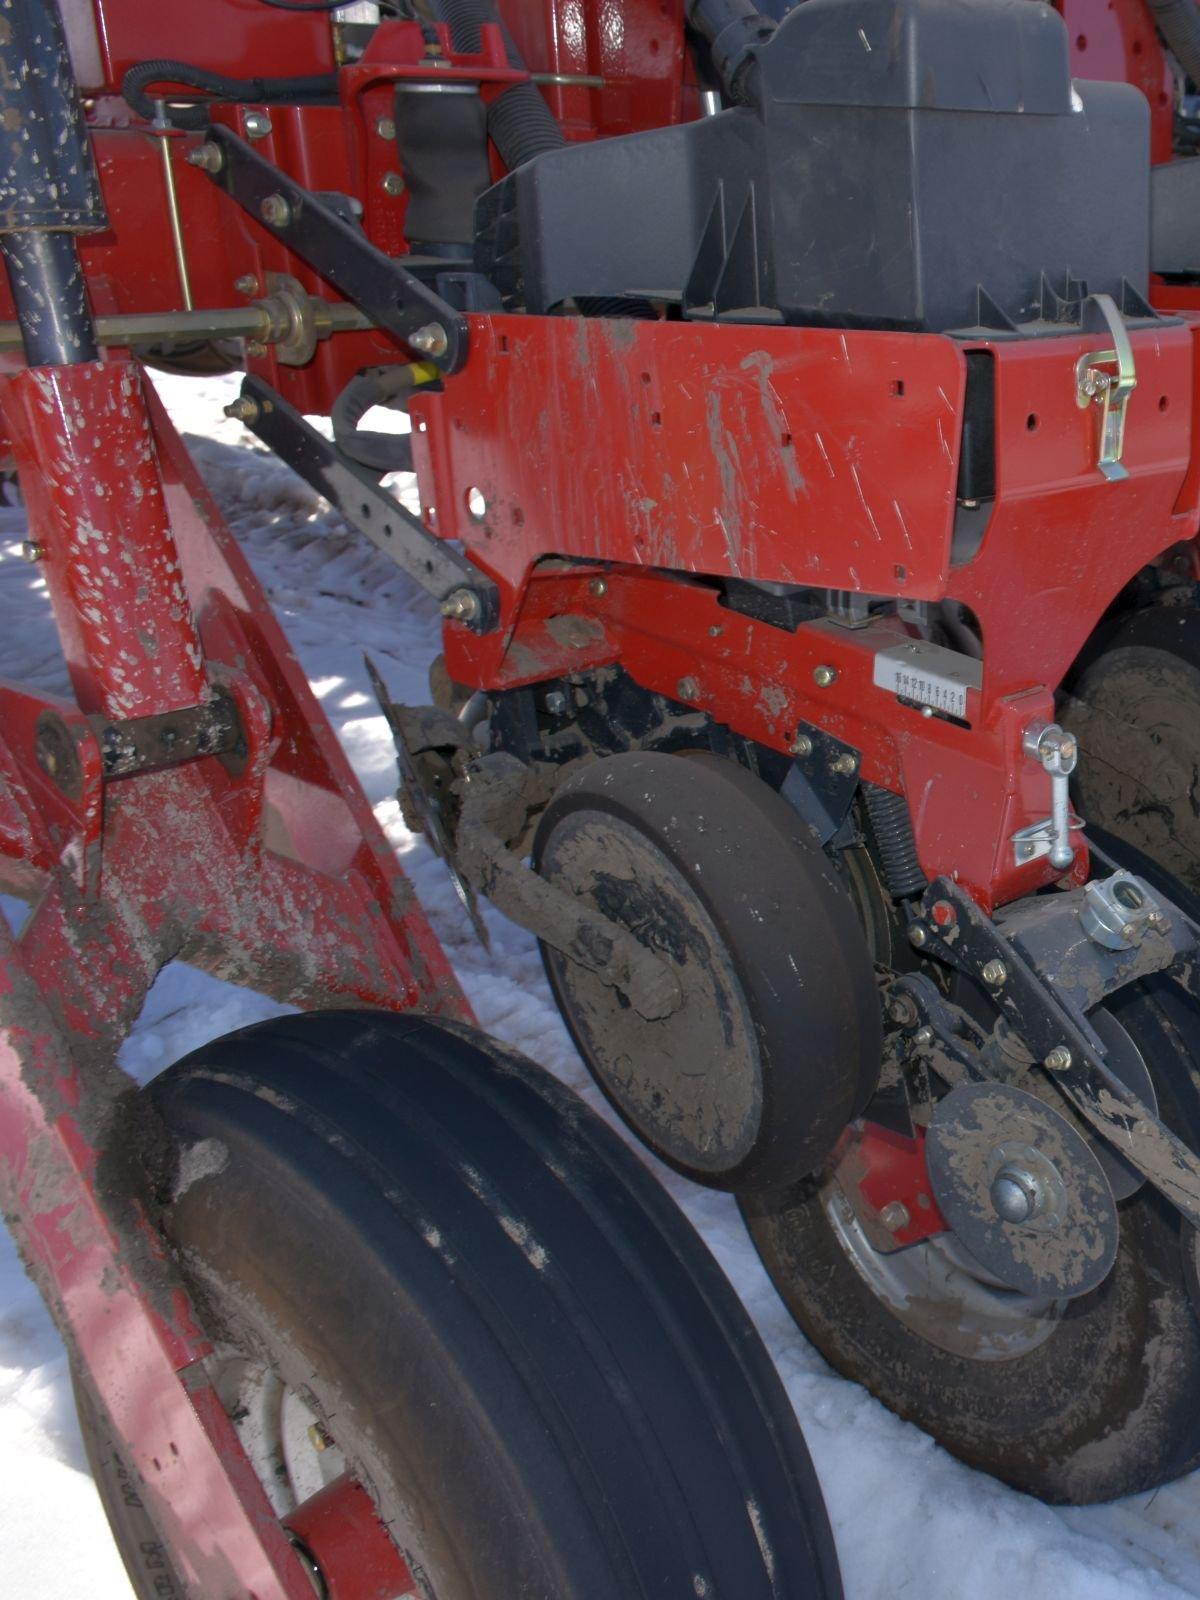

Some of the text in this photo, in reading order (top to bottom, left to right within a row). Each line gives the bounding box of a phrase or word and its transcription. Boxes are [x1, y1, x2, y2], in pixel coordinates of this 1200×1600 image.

[911, 678, 917, 689] 12
[950, 691, 956, 702] 2
[959, 694, 964, 706] 0
